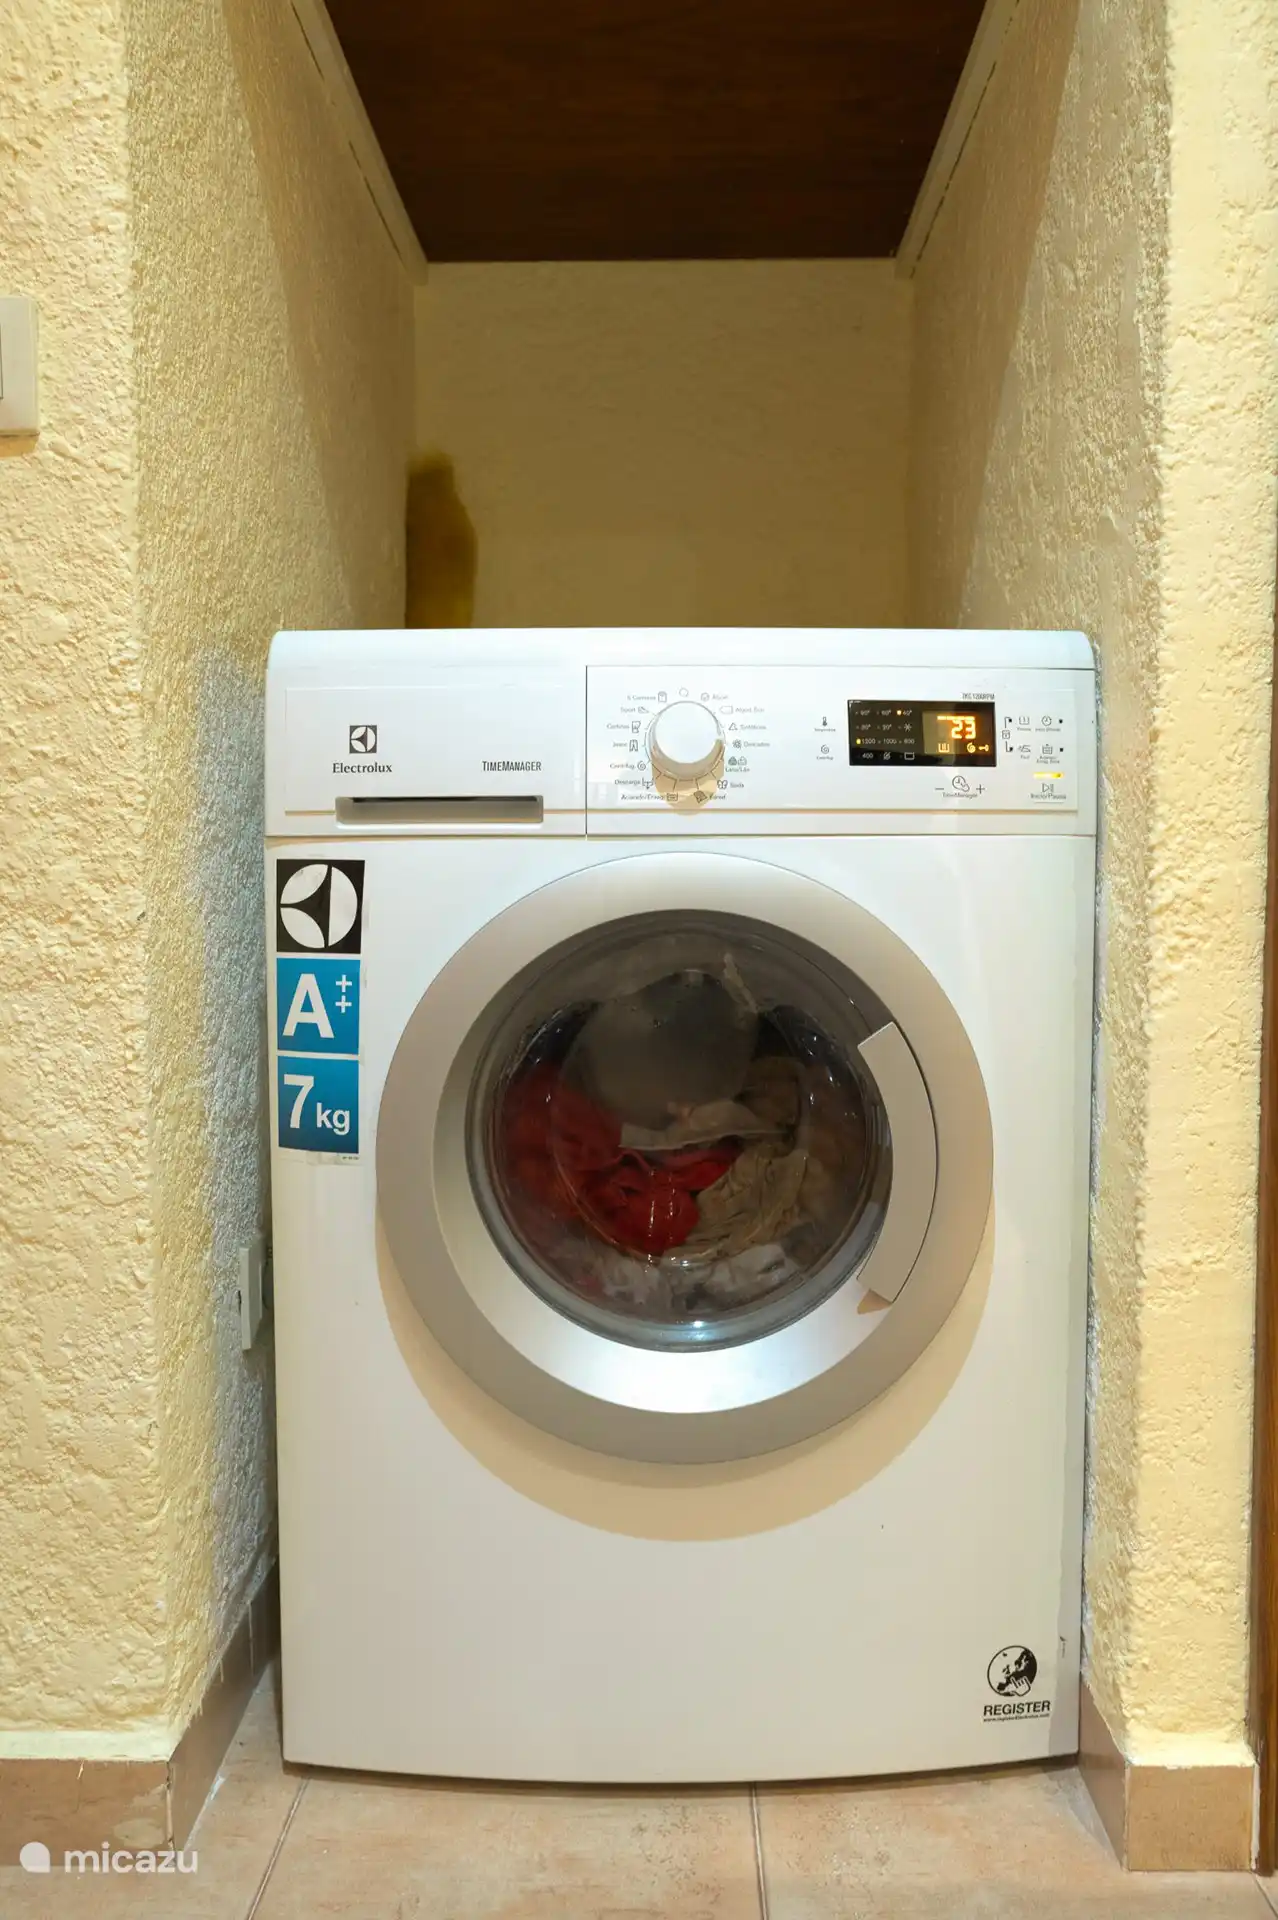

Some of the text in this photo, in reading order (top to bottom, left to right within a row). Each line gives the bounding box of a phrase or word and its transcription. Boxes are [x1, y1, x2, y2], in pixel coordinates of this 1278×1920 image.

[950, 719, 977, 739] 23
[332, 761, 393, 774] Electrolux
[984, 1700, 1051, 1716] REGISTER
